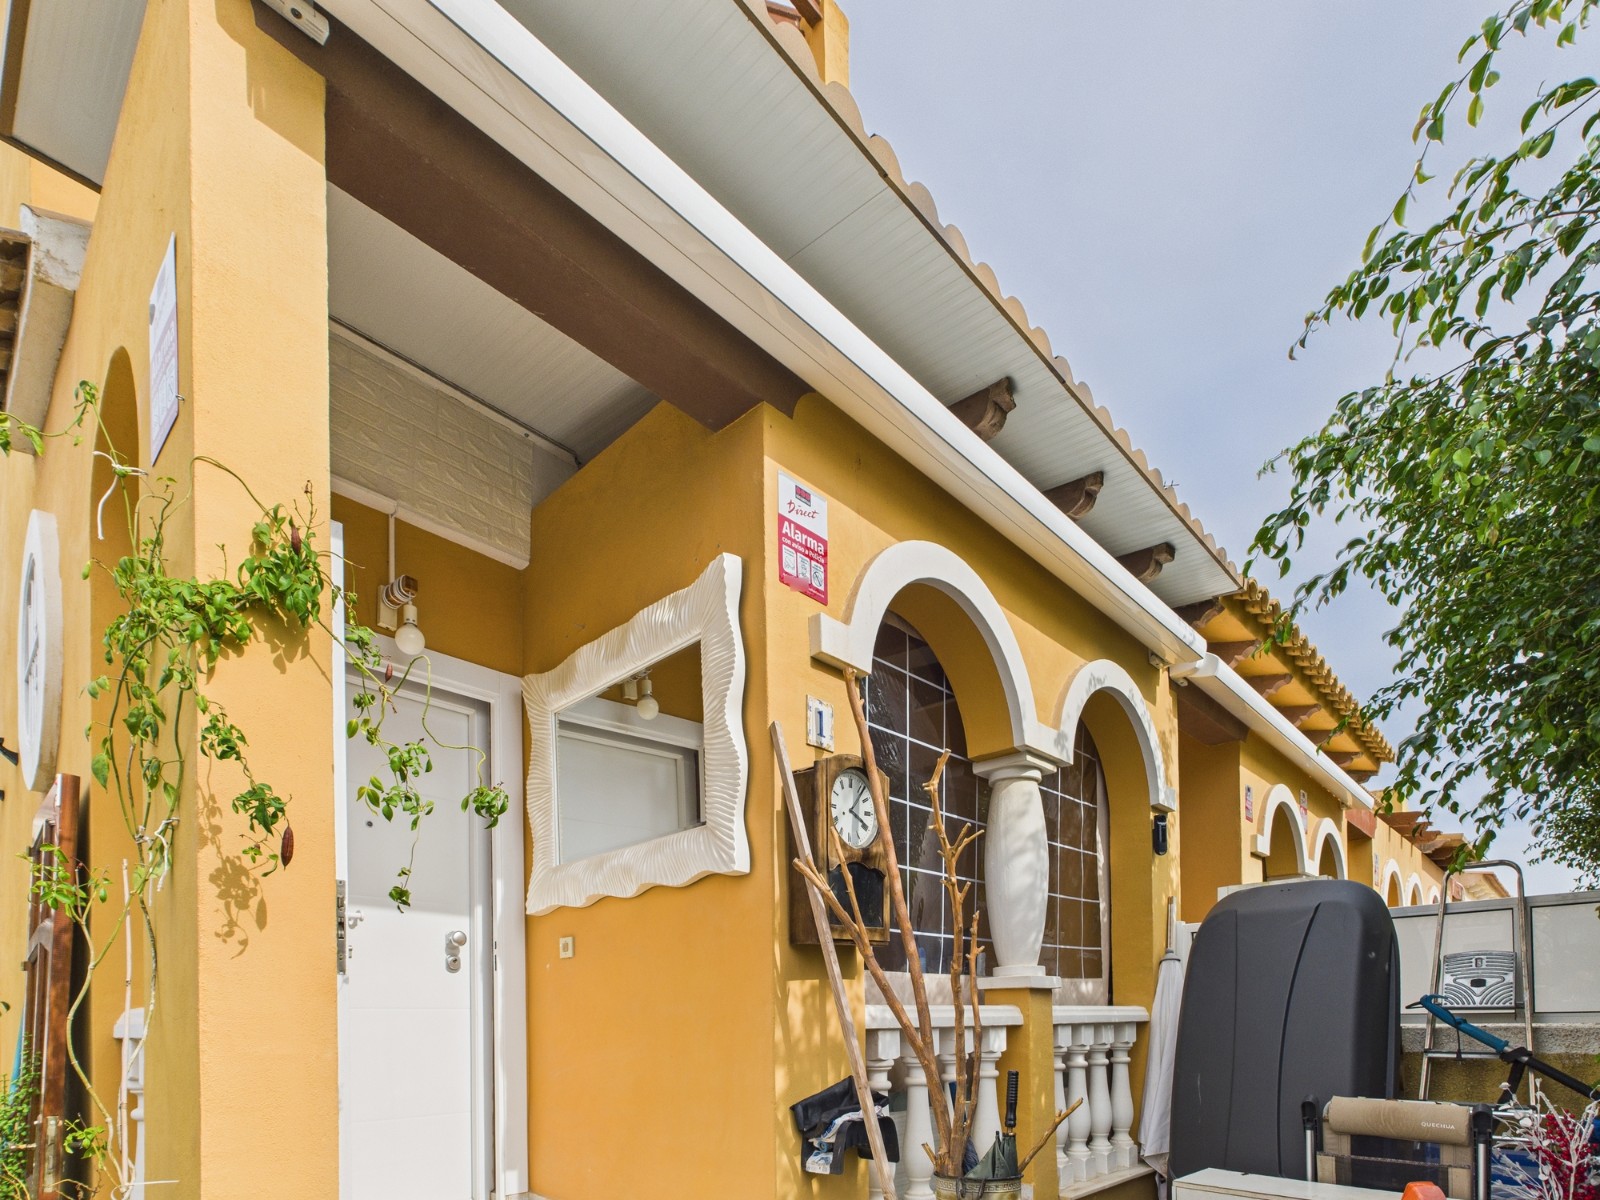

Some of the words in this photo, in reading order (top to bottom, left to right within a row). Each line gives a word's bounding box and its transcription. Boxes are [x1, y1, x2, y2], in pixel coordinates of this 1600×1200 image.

[787, 499, 819, 519] Direct
[782, 520, 825, 556] Alarma
[817, 710, 826, 738] 1
[1420, 1121, 1456, 1130] QUECHUA
